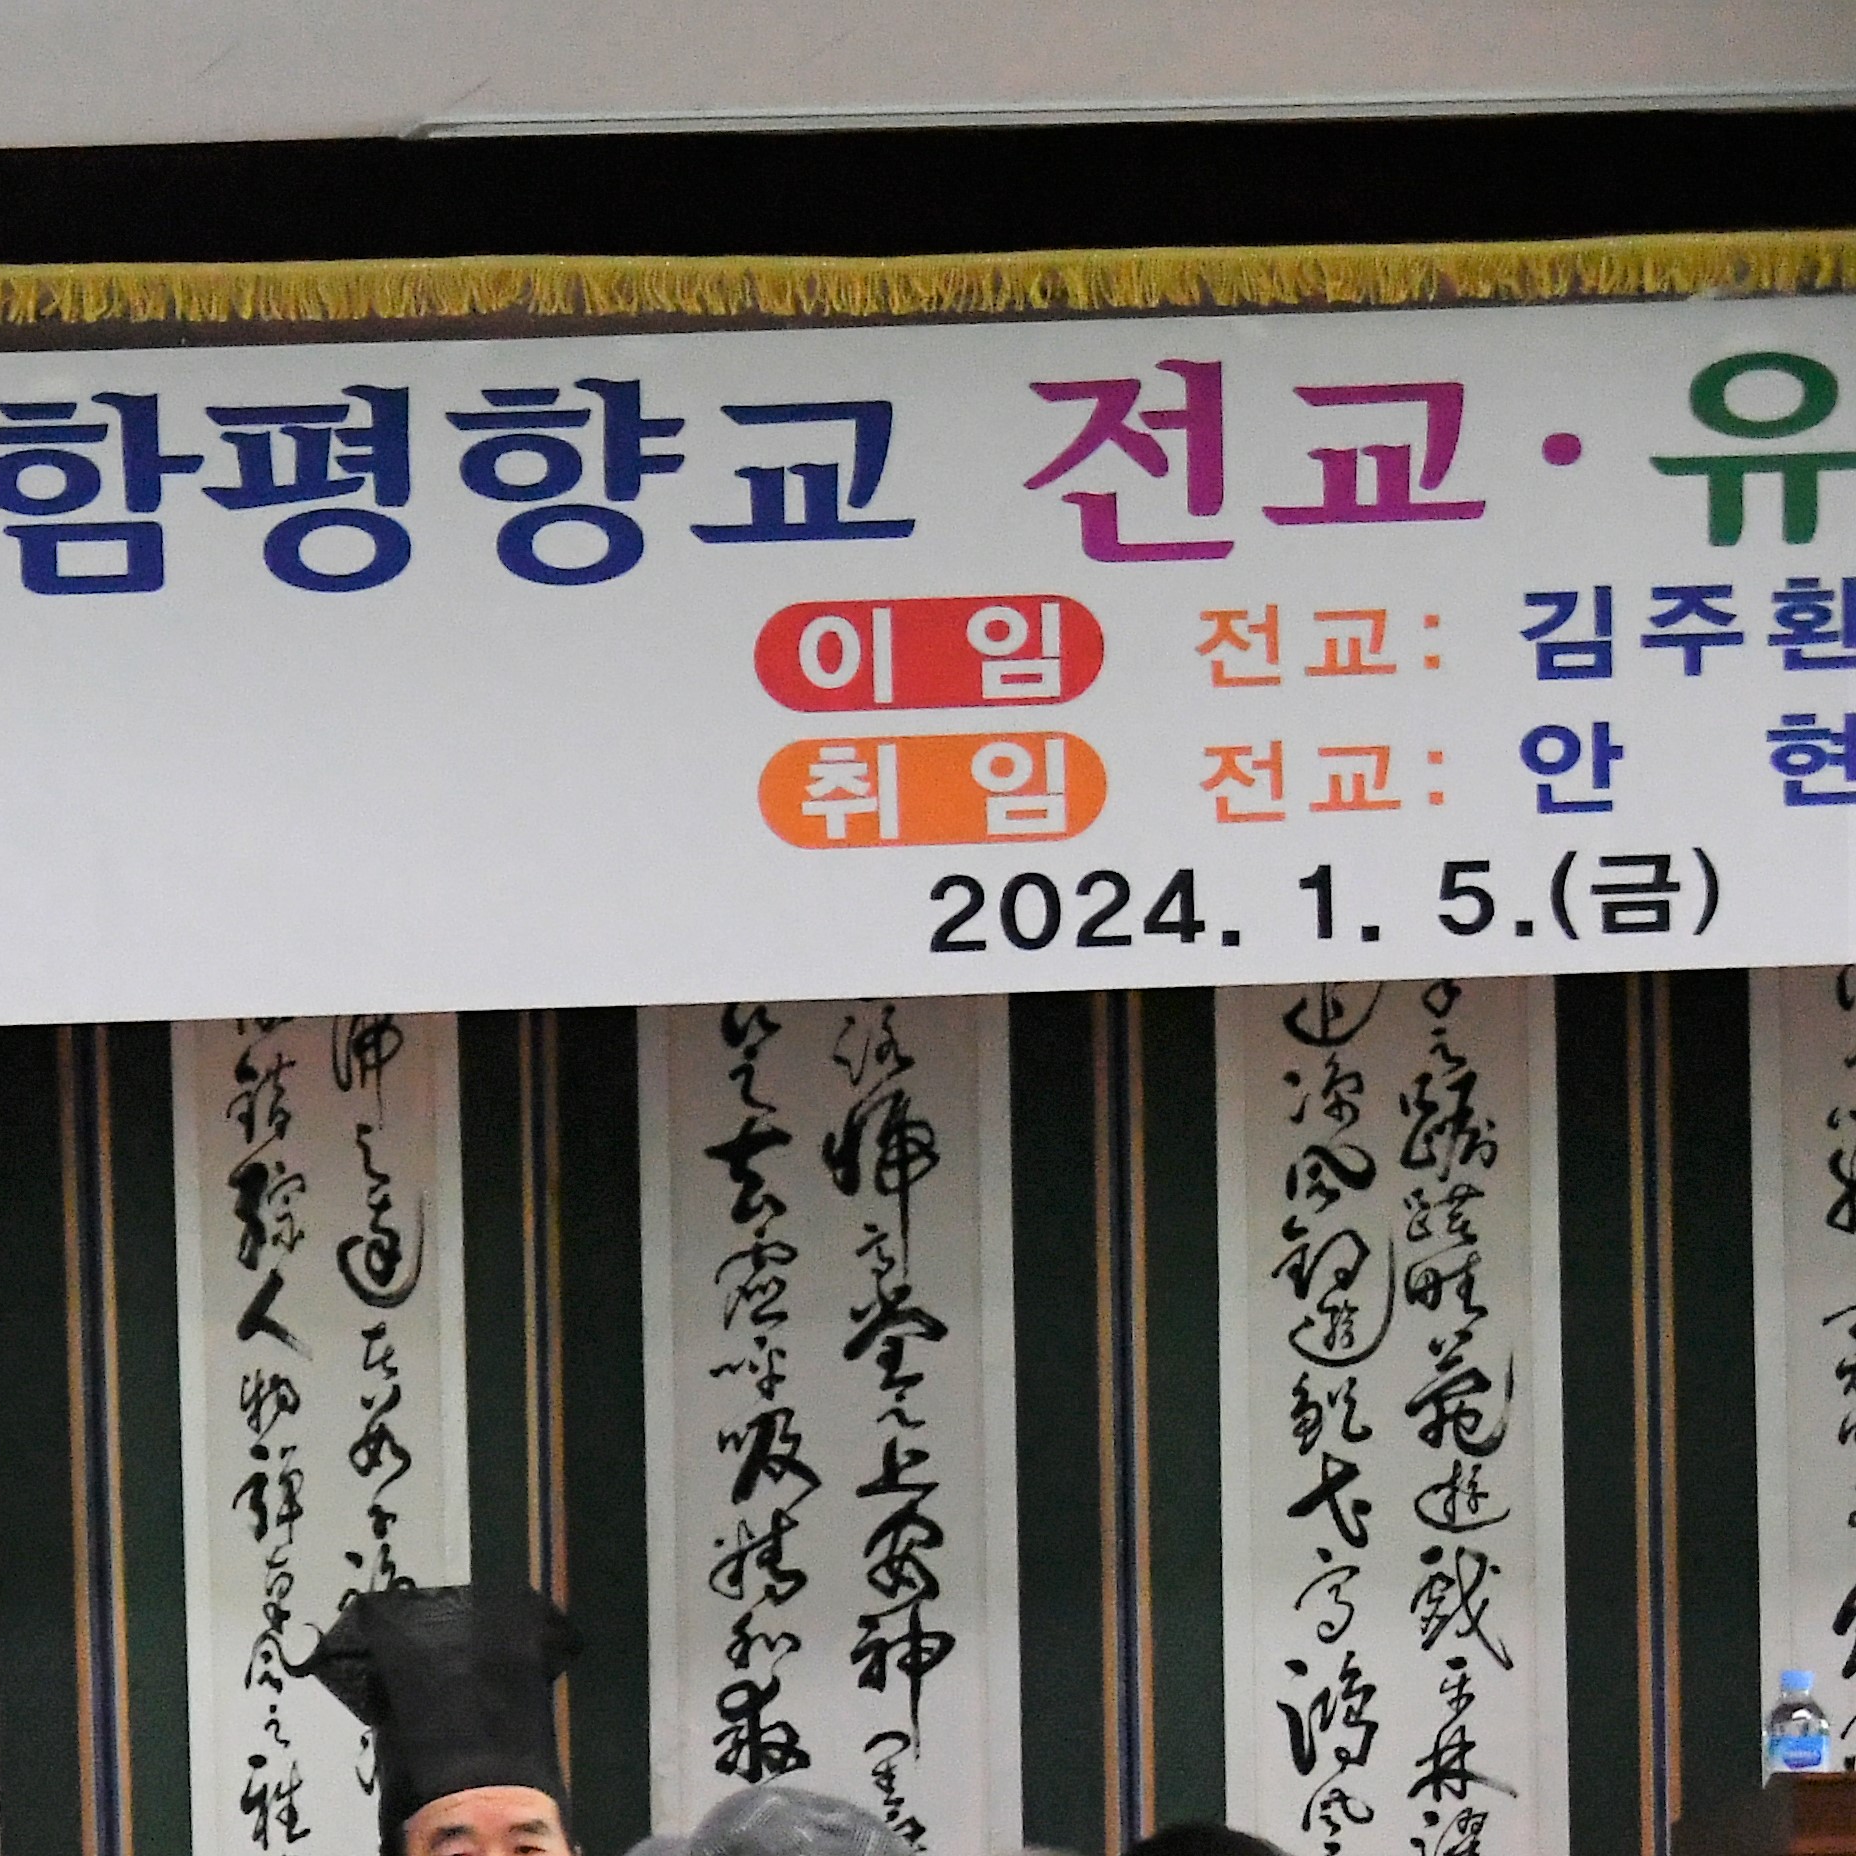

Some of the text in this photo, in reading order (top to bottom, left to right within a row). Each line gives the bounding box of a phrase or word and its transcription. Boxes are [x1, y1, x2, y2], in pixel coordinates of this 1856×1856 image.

[1193, 602, 1443, 690] 전교:
[1198, 738, 1447, 825] 전교:
[926, 866, 1244, 954] 2024.
[1296, 864, 1382, 944] 1.
